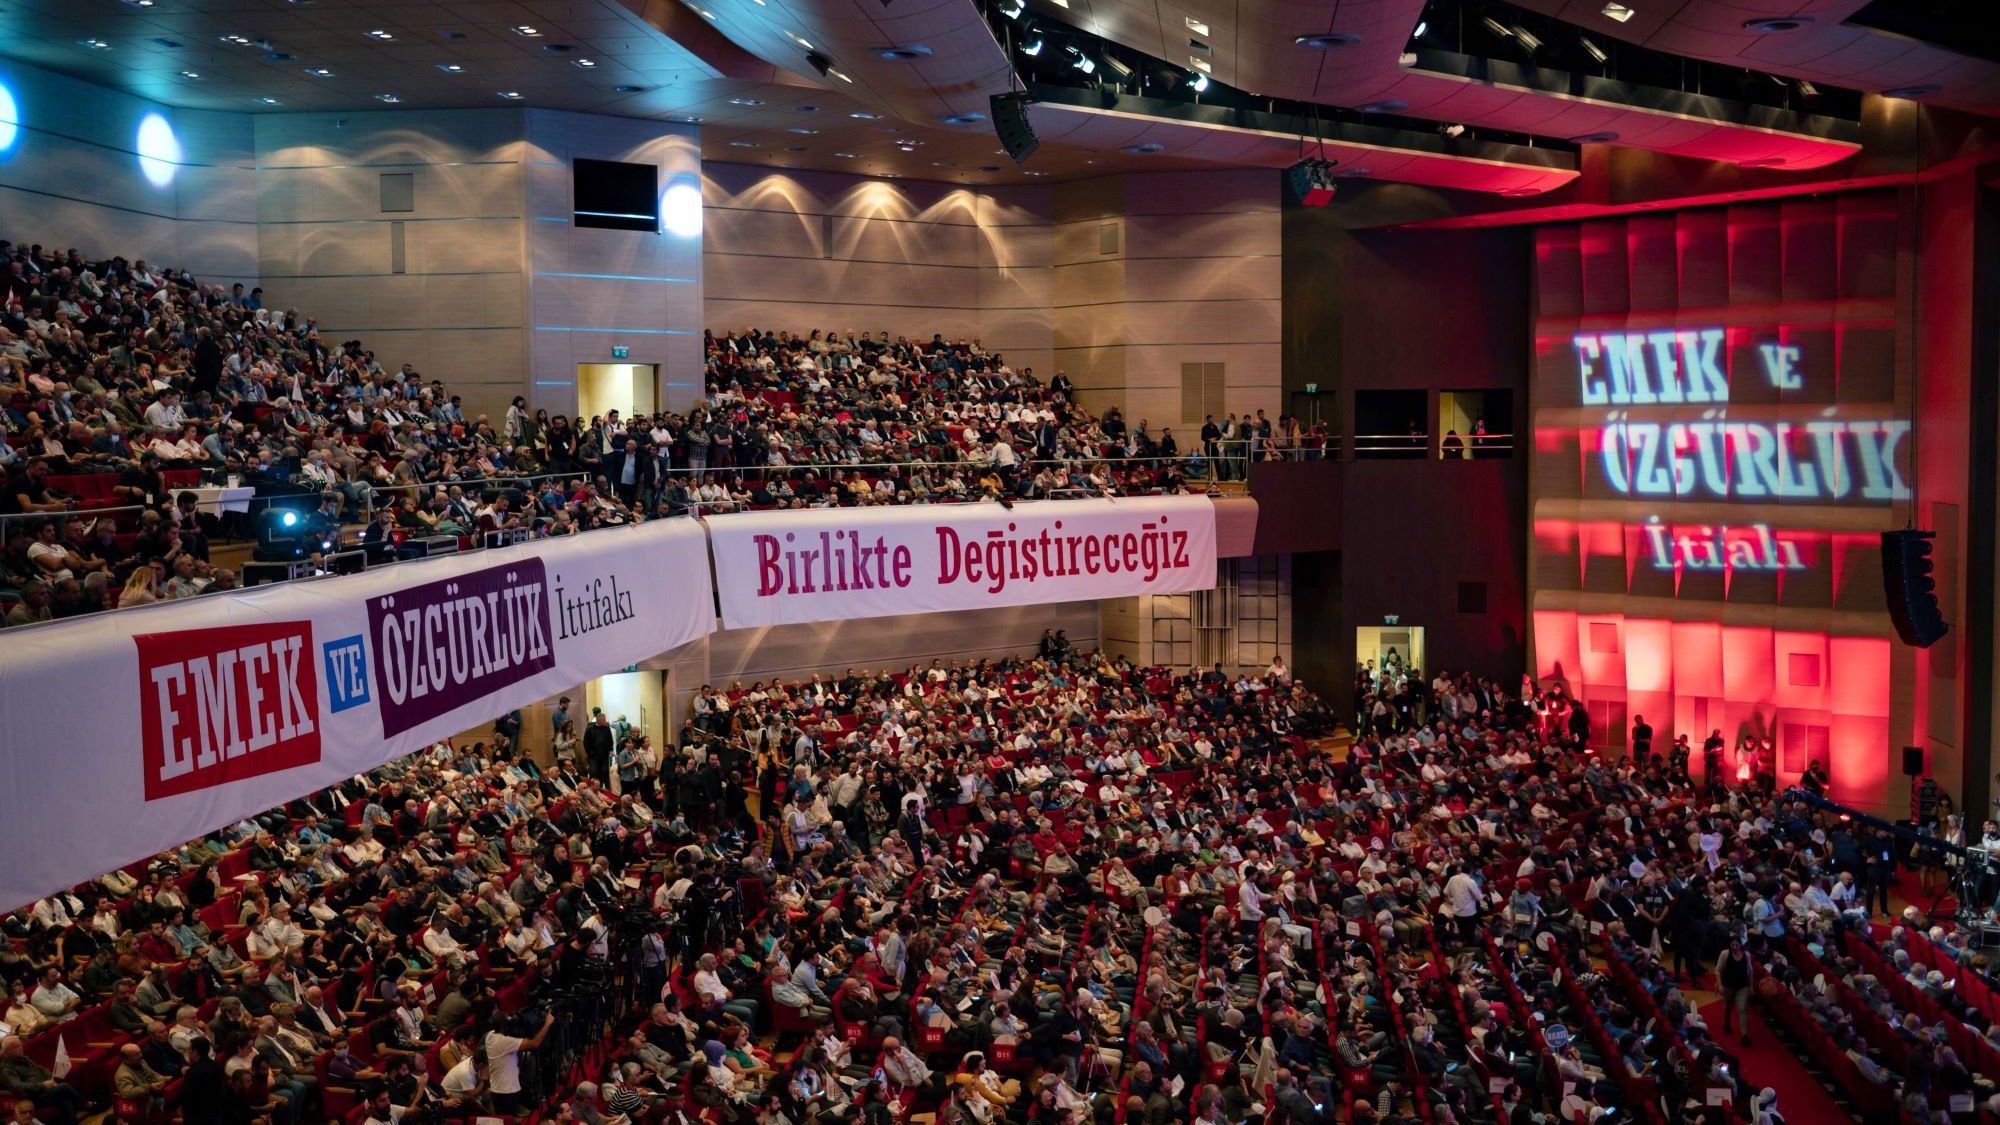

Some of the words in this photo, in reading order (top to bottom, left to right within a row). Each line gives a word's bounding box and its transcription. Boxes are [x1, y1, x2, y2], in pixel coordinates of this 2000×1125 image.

[1574, 330, 1729, 405] EMEK
[1760, 344, 1801, 389] VE
[753, 530, 912, 597] Birlikte
[936, 516, 1190, 594] Değiştireceğiz
[151, 634, 314, 781] EMEK
[329, 643, 364, 702] VE
[381, 572, 548, 705] ÖZGÜRLÜK
[555, 574, 635, 640] İttifakı
